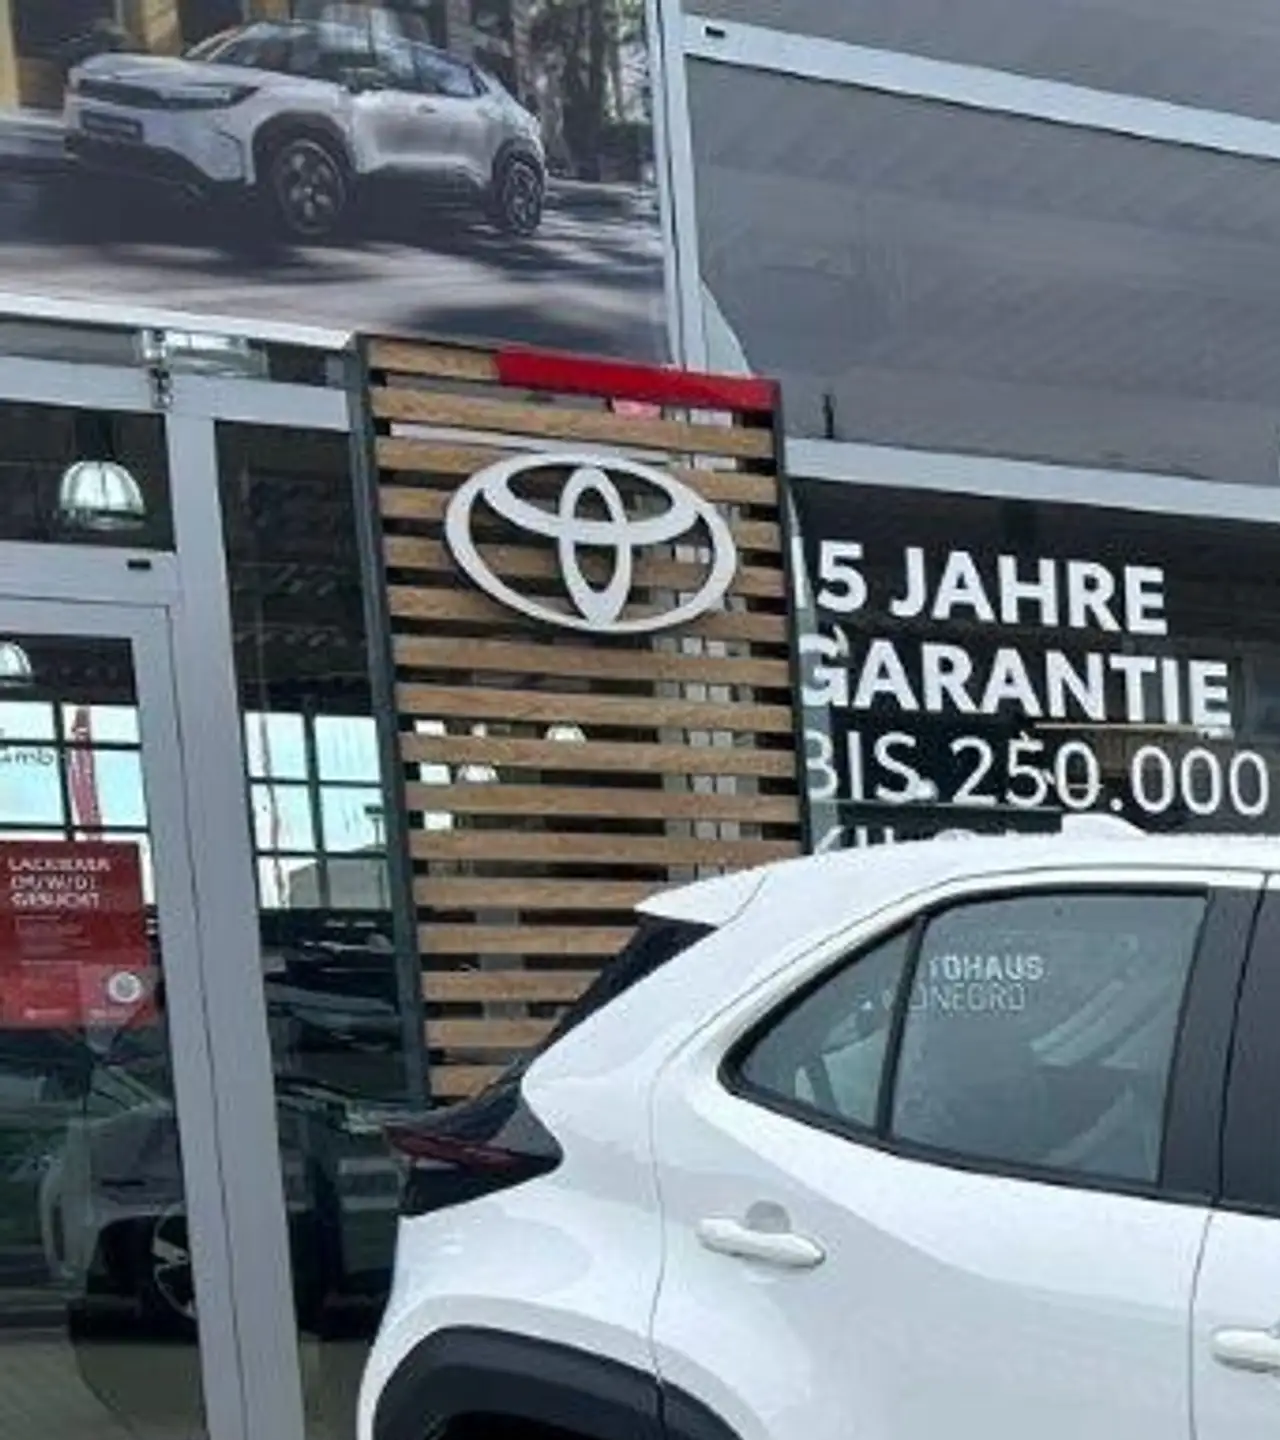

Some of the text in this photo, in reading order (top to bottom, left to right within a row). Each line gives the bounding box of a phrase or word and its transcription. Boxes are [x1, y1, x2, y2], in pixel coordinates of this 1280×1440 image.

[889, 545, 1168, 636] JAHRE
[799, 634, 1233, 727] GARANTIE
[949, 735, 1270, 817] 250.000
